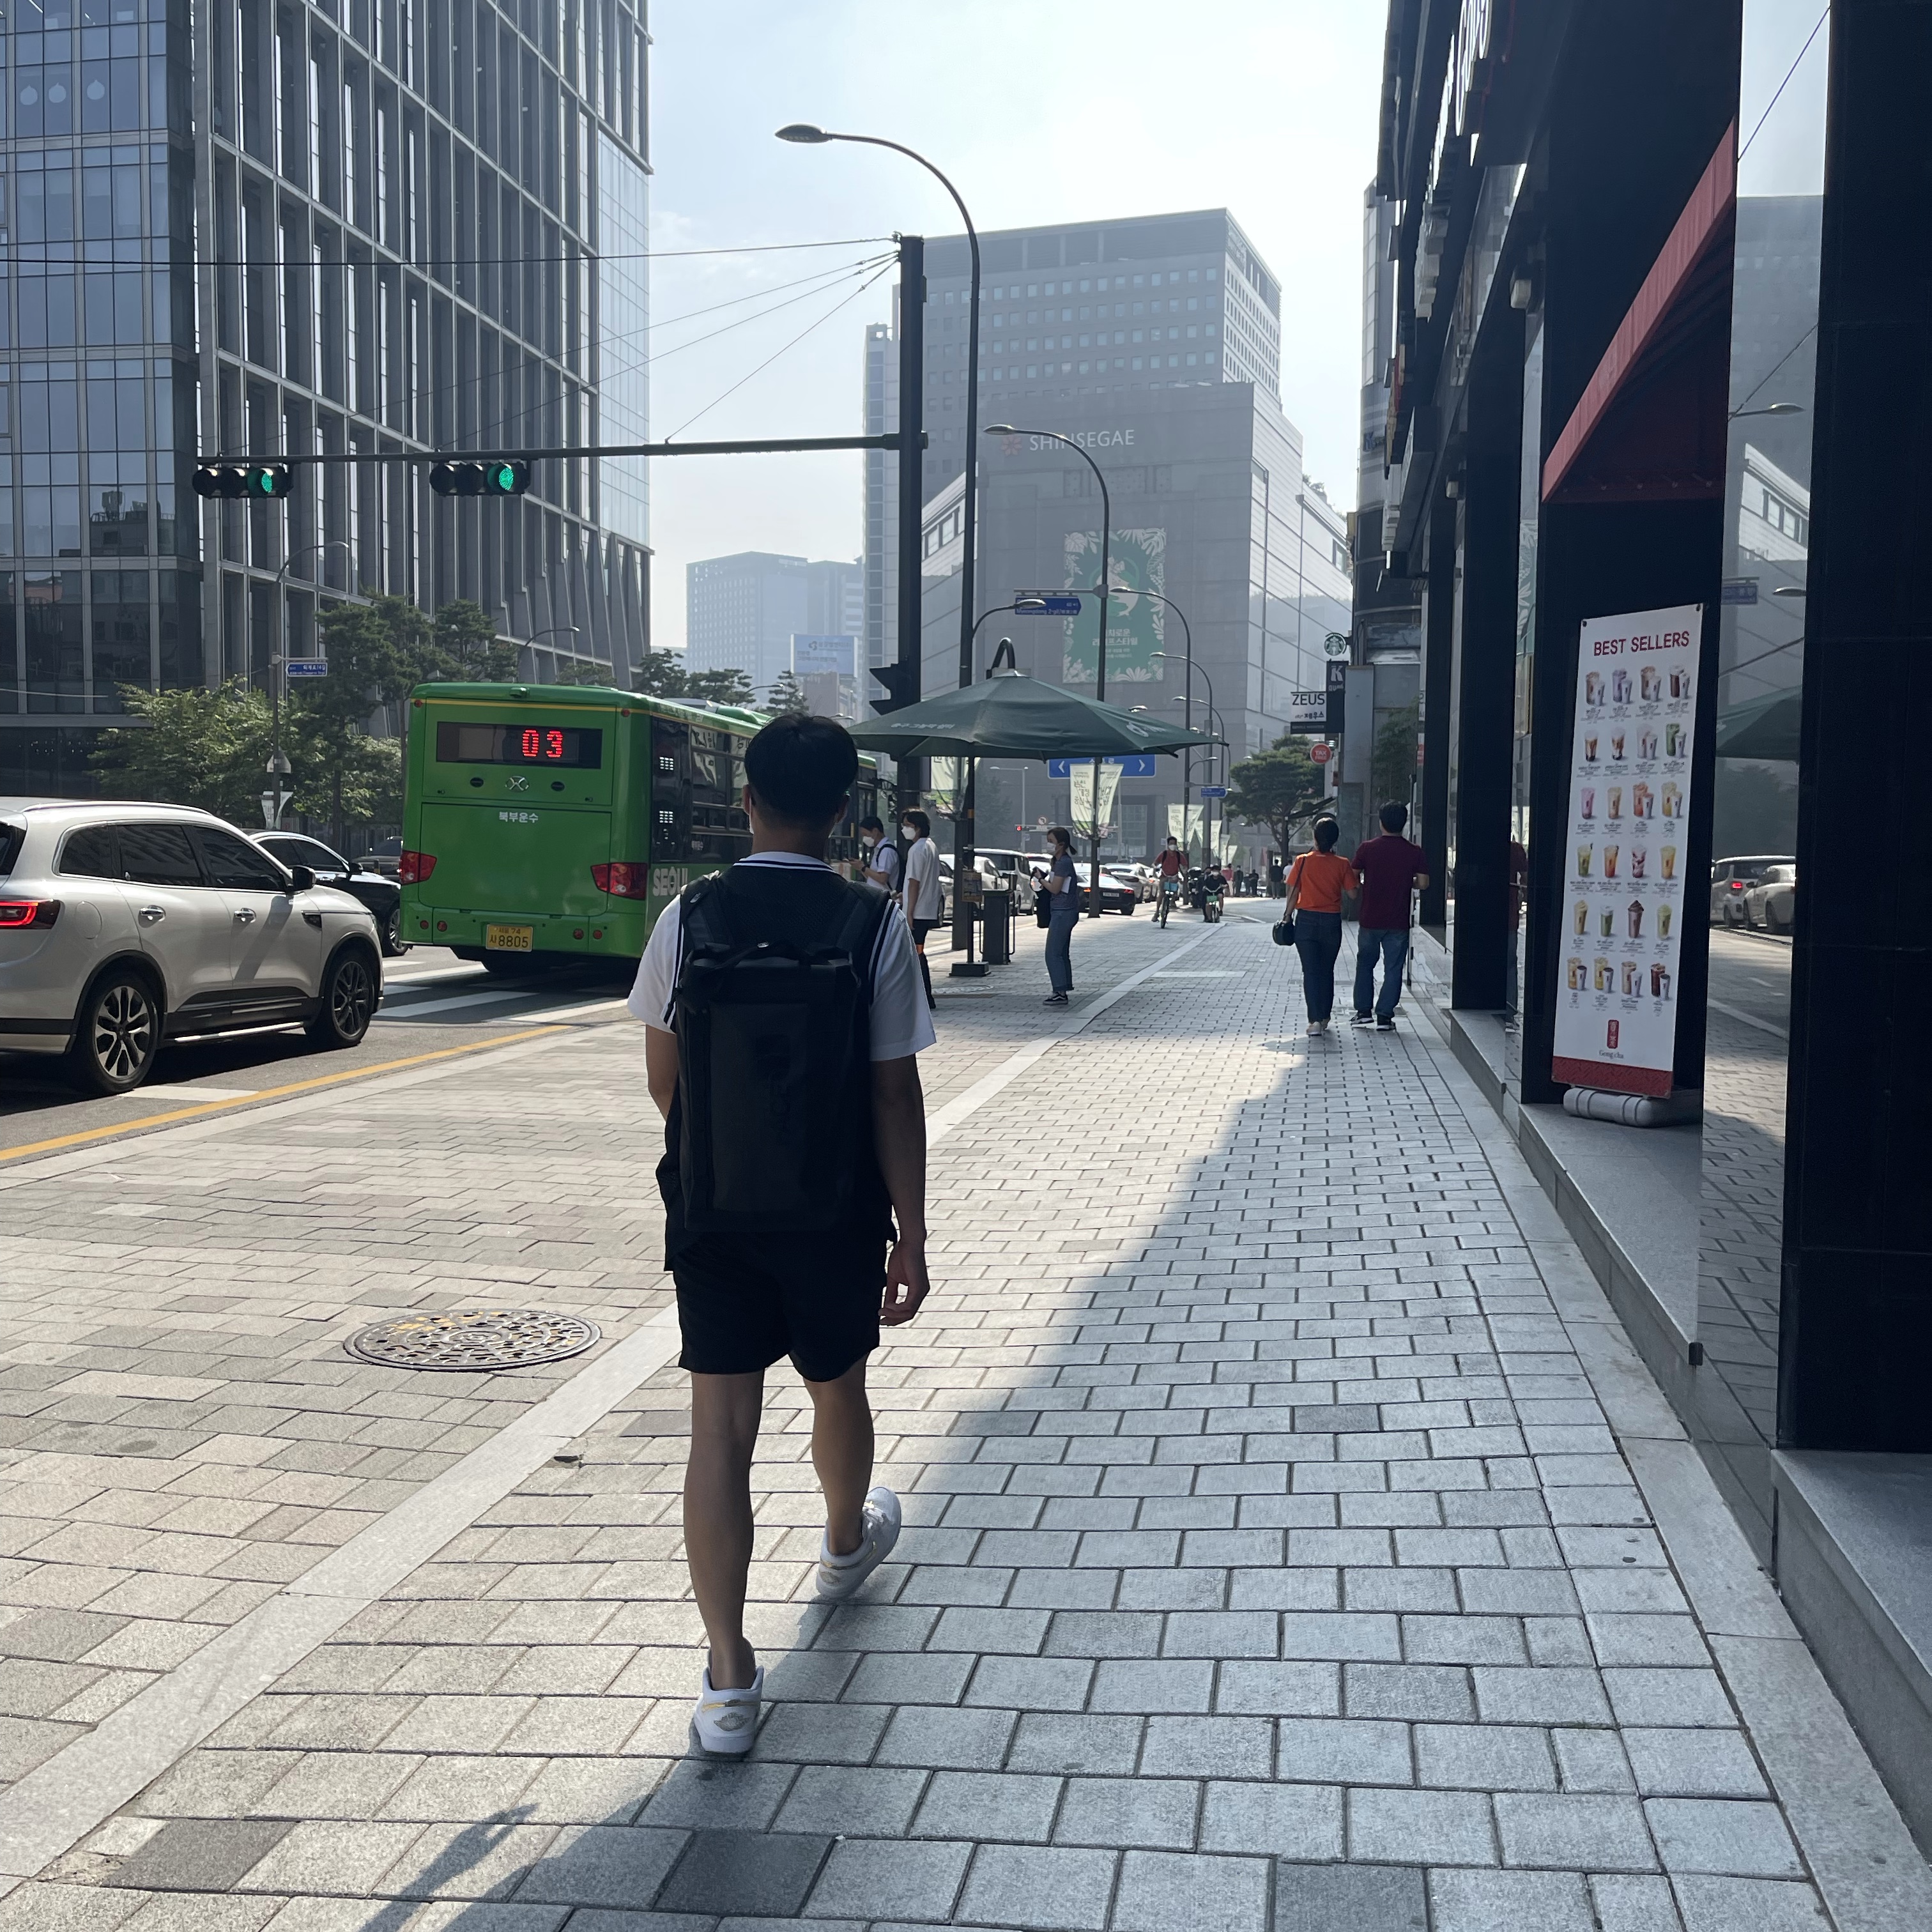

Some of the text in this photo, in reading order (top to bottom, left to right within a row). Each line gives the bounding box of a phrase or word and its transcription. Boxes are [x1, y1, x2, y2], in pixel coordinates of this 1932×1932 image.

[1030, 429, 1135, 451] SHINSEGAE
[1106, 629, 1130, 637] 치로운
[1594, 631, 1690, 656] BEST SELLERS
[1330, 666, 1343, 682] K
[1292, 694, 1325, 705] ZEUS
[522, 730, 563, 758] 03
[499, 811, 539, 824] 북부운수
